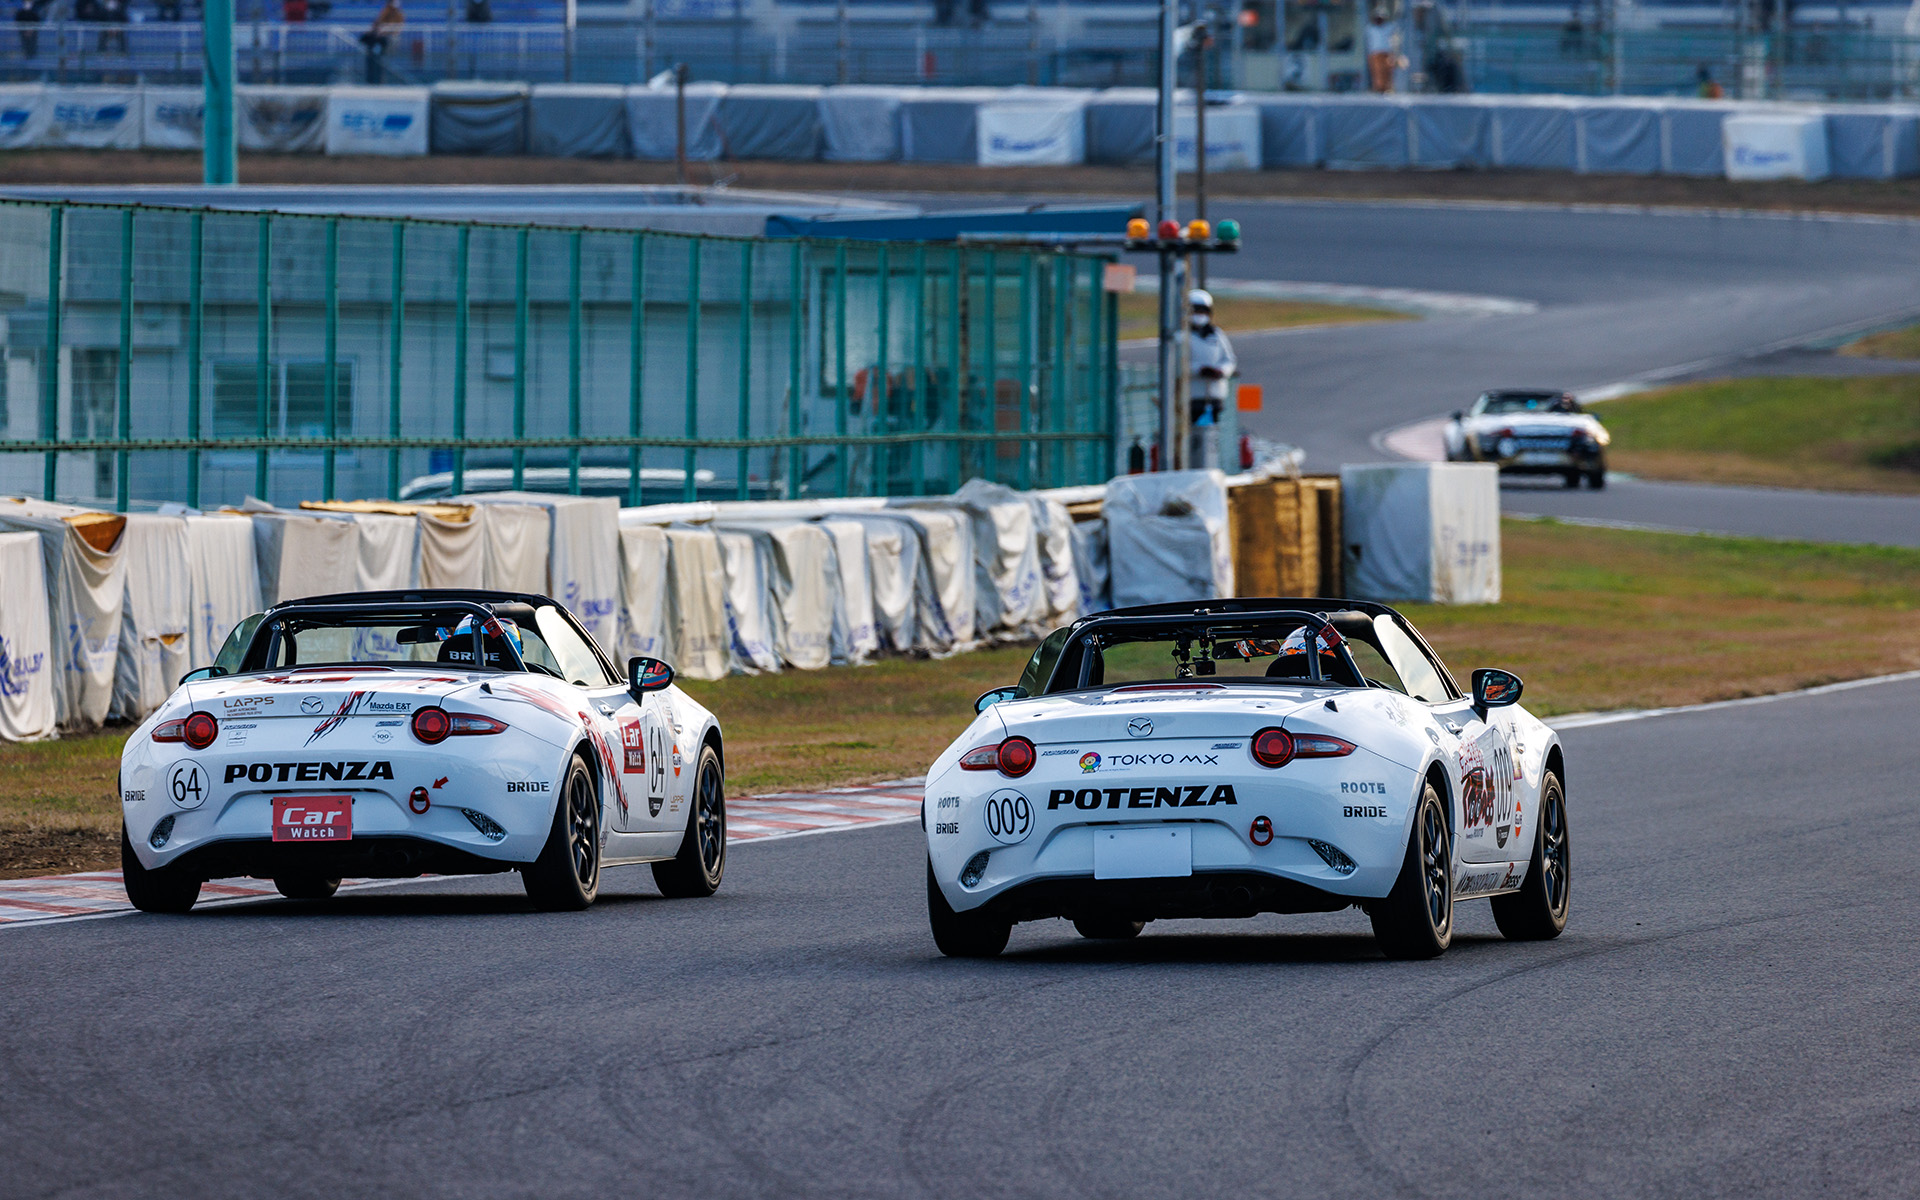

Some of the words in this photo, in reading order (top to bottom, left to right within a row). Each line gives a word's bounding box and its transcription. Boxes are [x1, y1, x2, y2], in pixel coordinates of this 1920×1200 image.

[224, 696, 274, 708] LAPPS
[369, 702, 394, 710] Mazda
[395, 702, 411, 710] E&T
[621, 721, 640, 747] Car
[650, 726, 665, 793] 64
[1108, 753, 1174, 766] TOKYO
[1179, 754, 1219, 766] MX
[223, 761, 394, 784] POTENZA
[172, 767, 202, 802] 64
[506, 781, 550, 793] BRIDE
[1340, 781, 1386, 794] ROOTS
[1494, 747, 1512, 823] 009
[124, 790, 145, 802] BRIDE
[937, 796, 960, 809] ROOTS
[1047, 784, 1238, 810] POTENZA
[281, 807, 343, 826] Car
[987, 796, 1030, 836] 009
[1343, 805, 1388, 818] BRIDE
[290, 827, 335, 838] Watch
[936, 822, 959, 835] BRIDE
